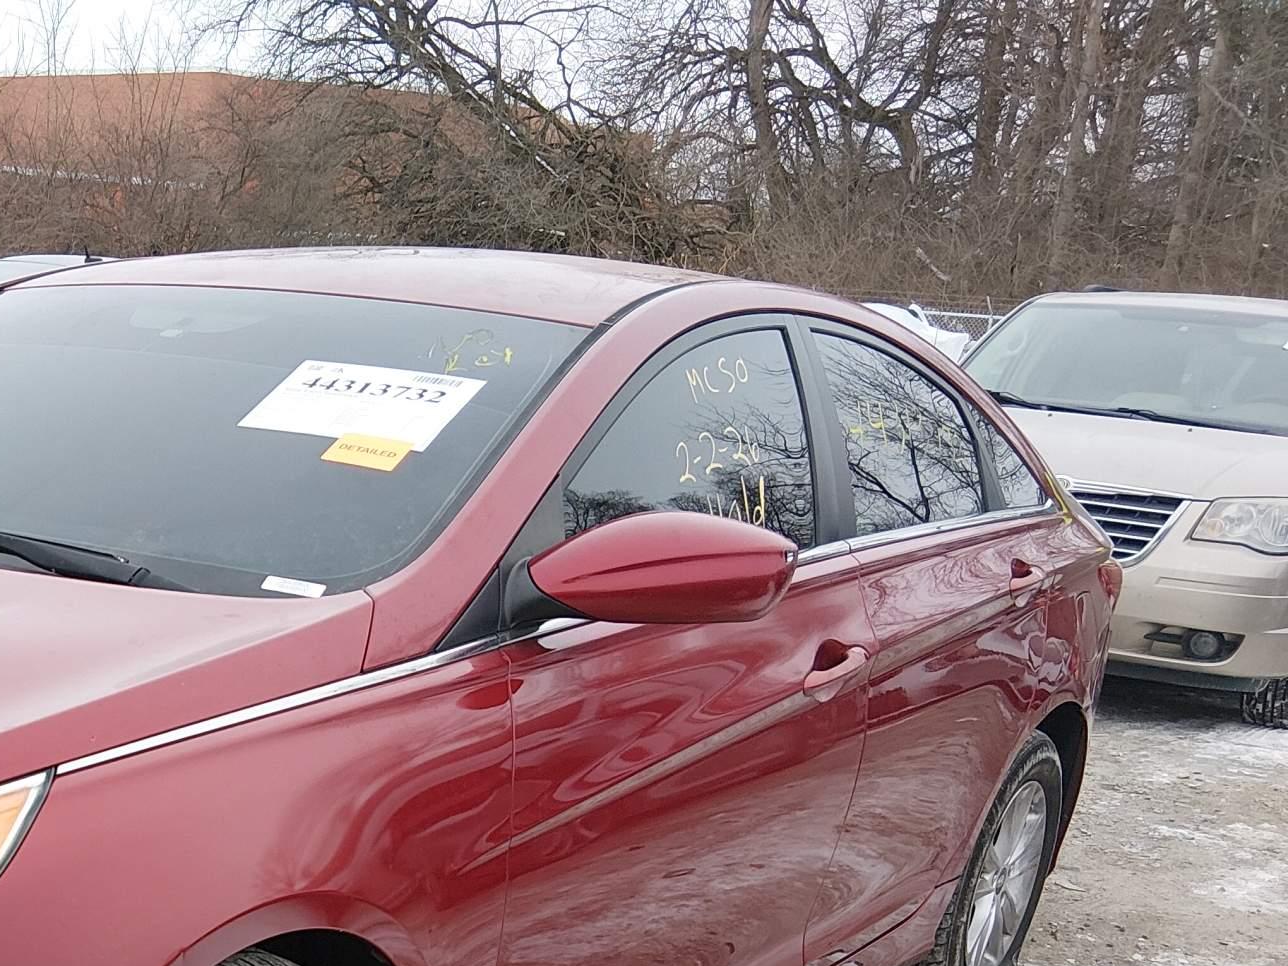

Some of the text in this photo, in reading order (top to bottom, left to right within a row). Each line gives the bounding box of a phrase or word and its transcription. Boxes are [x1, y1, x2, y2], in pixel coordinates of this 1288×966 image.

[302, 377, 447, 404] 44313732
[338, 443, 397, 459] DETAILED
[676, 425, 760, 483] 2-2-26
